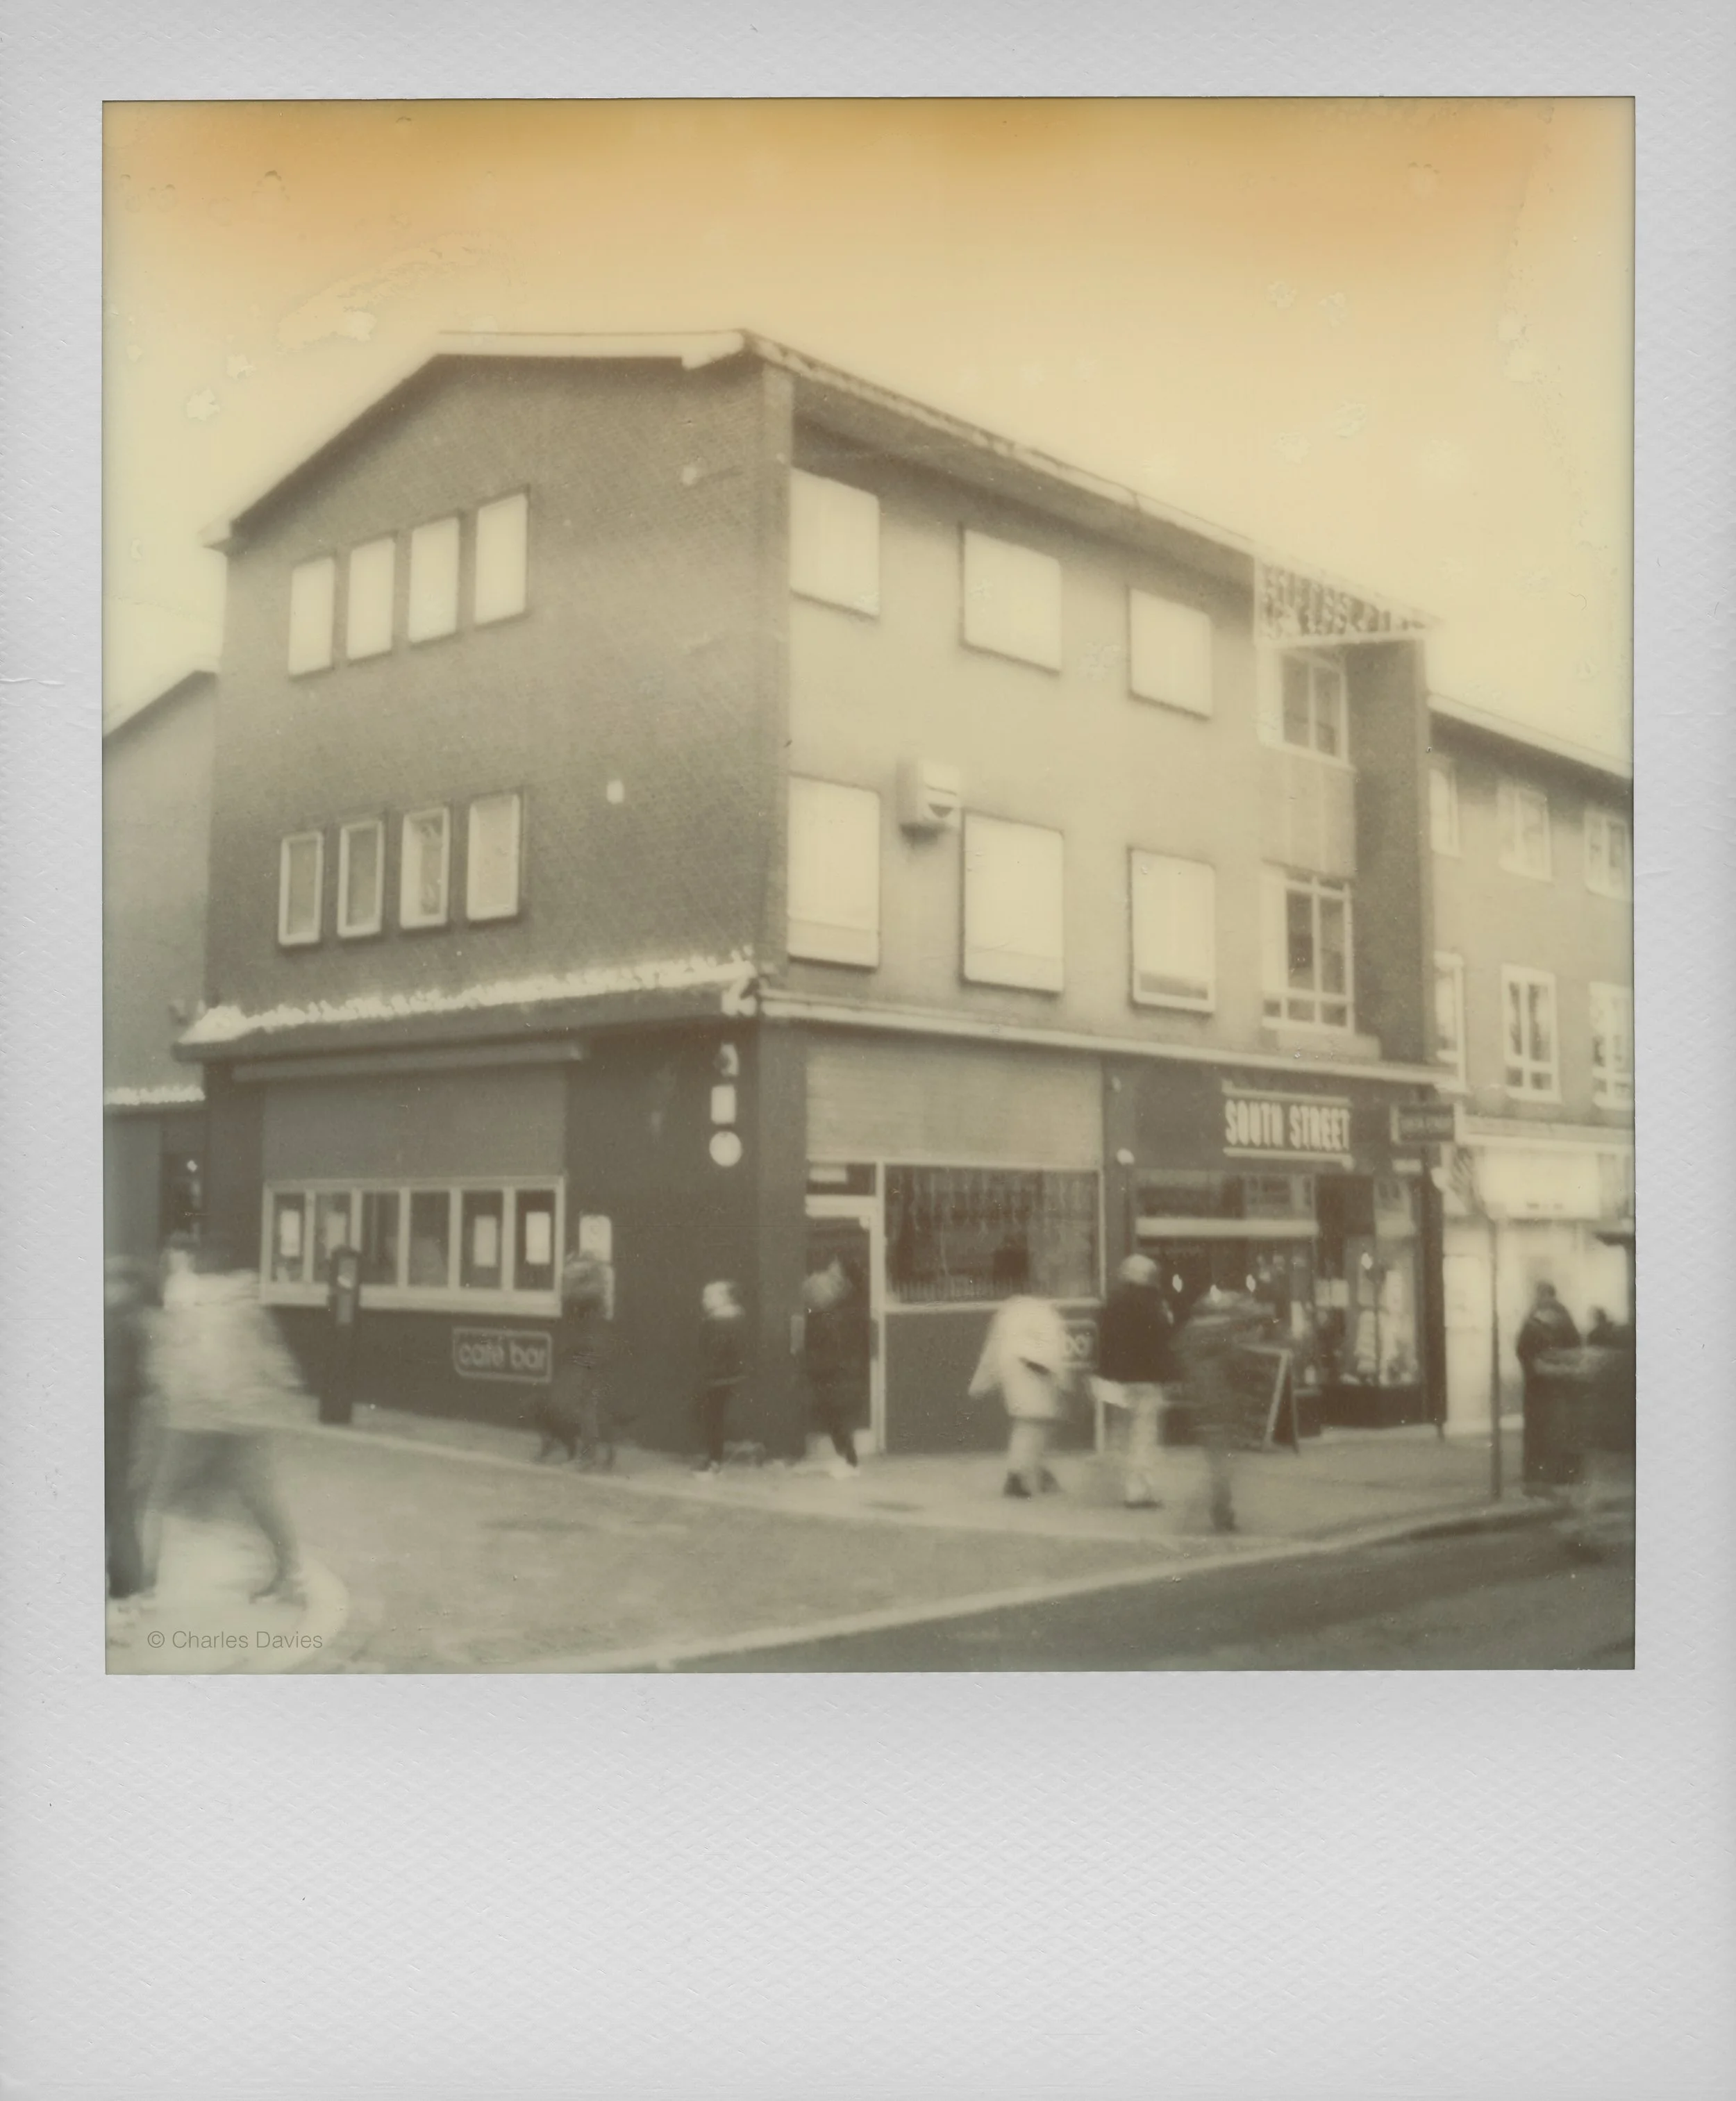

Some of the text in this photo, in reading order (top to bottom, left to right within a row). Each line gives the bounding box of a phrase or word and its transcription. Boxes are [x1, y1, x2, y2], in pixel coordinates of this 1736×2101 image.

[1225, 1099, 1350, 1152] SOUTH STREET
[509, 1339, 545, 1371] bar
